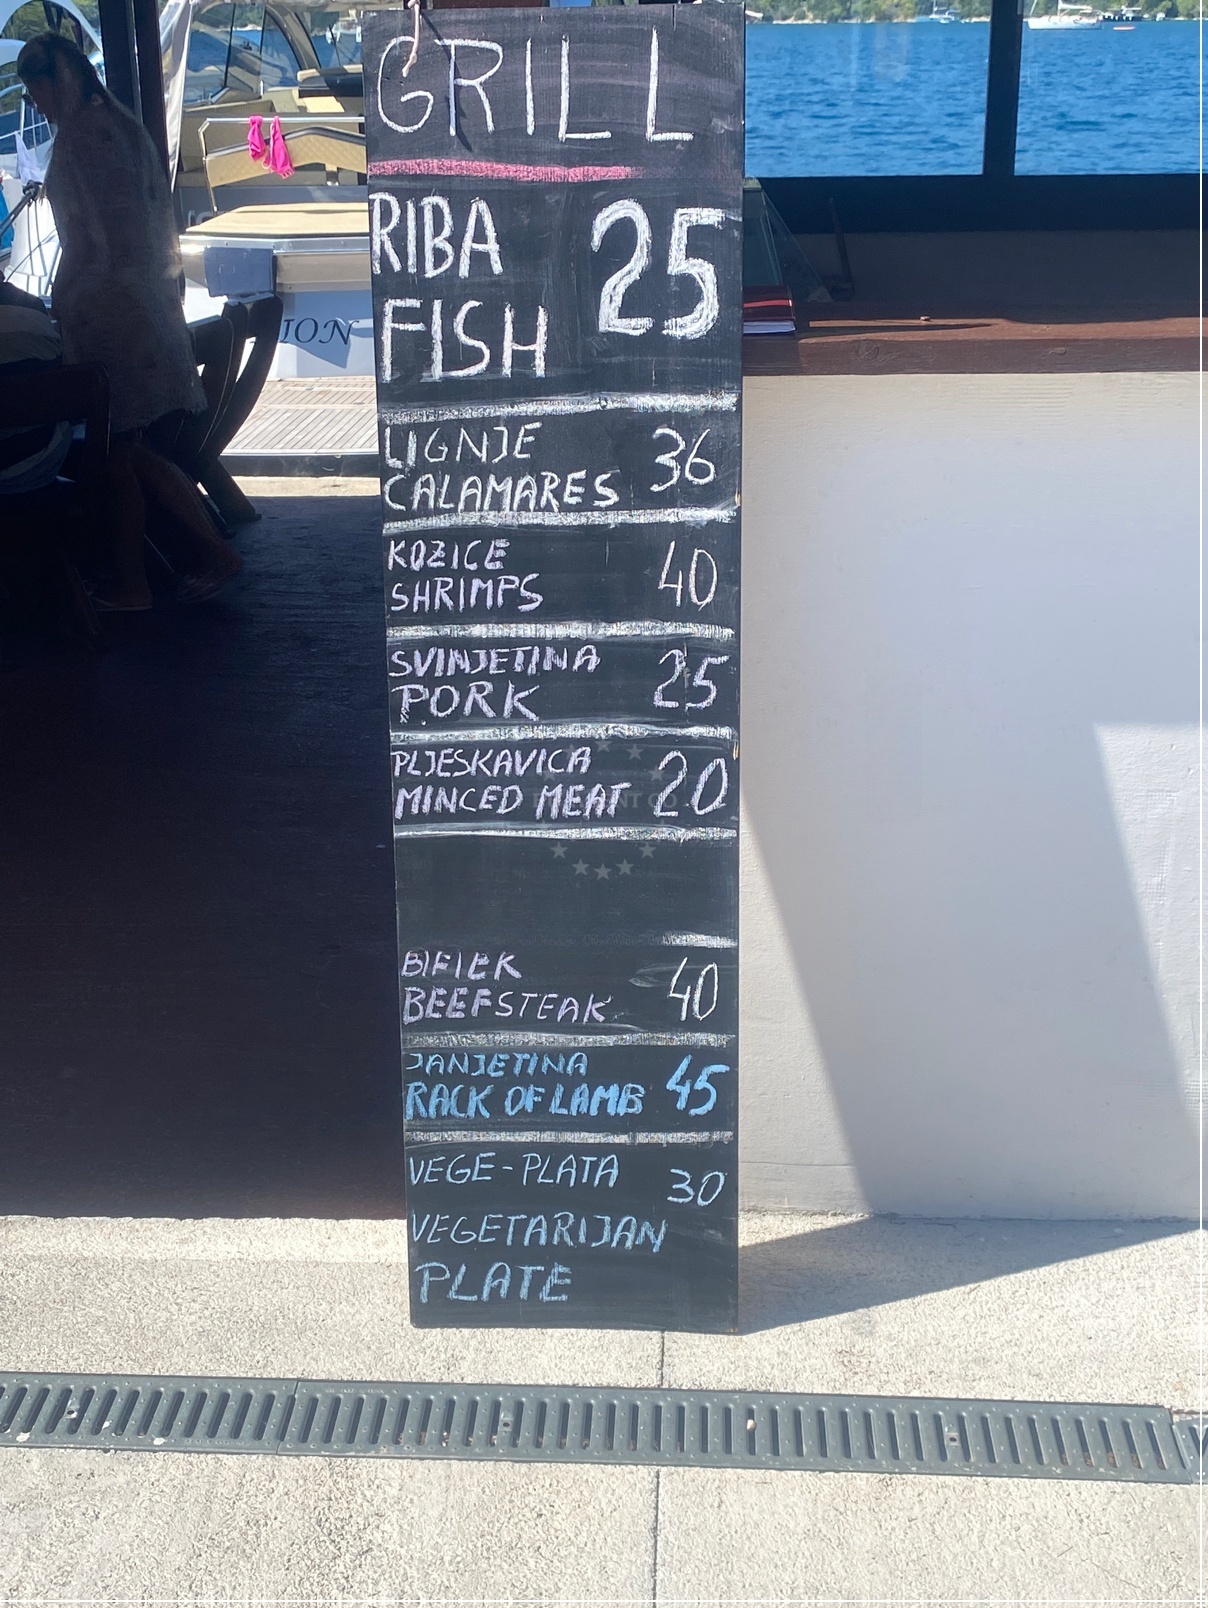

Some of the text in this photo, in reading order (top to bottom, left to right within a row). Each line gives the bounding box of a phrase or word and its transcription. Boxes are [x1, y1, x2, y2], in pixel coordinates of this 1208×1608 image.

[377, 26, 694, 142] GRILL
[369, 191, 503, 278] RIBA
[591, 199, 725, 339] 25
[381, 298, 548, 383] FISH
[384, 421, 542, 468] LIGNJE
[650, 427, 716, 492] 36
[384, 469, 619, 512] CALAMARES
[391, 573, 543, 612] SHRIMPS
[658, 540, 717, 611] 40
[389, 644, 601, 677] SVINJETINA
[654, 648, 729, 709] 25
[391, 680, 540, 723] PORK
[391, 747, 592, 777] PLJESKAVICA
[395, 785, 523, 819] MINCED
[535, 782, 632, 819] MEAT
[653, 751, 729, 817] 20
[403, 986, 613, 1024] BEEFSTEAK
[667, 957, 719, 1021] 40
[405, 1051, 588, 1076] JANJETINA
[666, 1054, 730, 1116] 45
[405, 1080, 645, 1120] RACK OF LAMB
[668, 1169, 727, 1206] 30
[412, 1212, 667, 1253] VEGETARIJAN
[414, 1262, 572, 1303] PLATE
